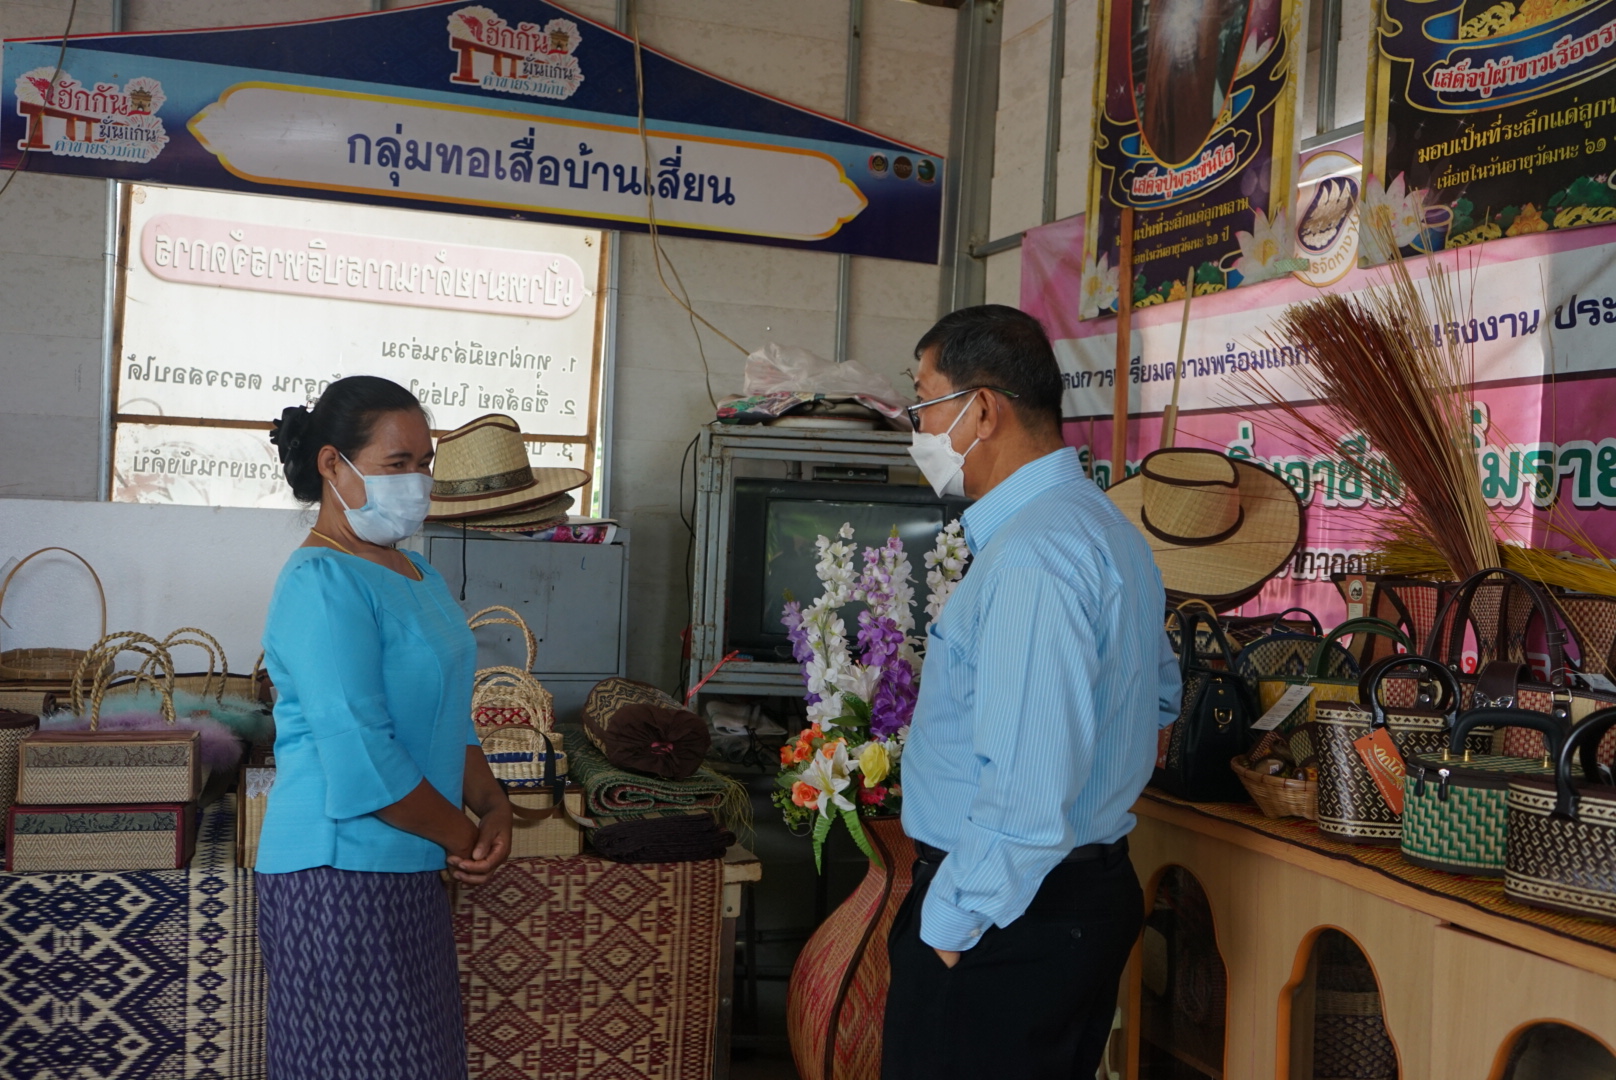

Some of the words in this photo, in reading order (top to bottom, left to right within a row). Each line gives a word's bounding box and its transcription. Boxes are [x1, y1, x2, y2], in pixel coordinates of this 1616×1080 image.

[486, 18, 548, 53] ฮักกัน
[1433, 23, 1616, 95] เสด็จปู่ผ้าขาวเรืองร
[58, 80, 128, 116] ฮักกัน
[347, 123, 735, 206] กลุ่มทอเสื่อบ้านเสี่ยน
